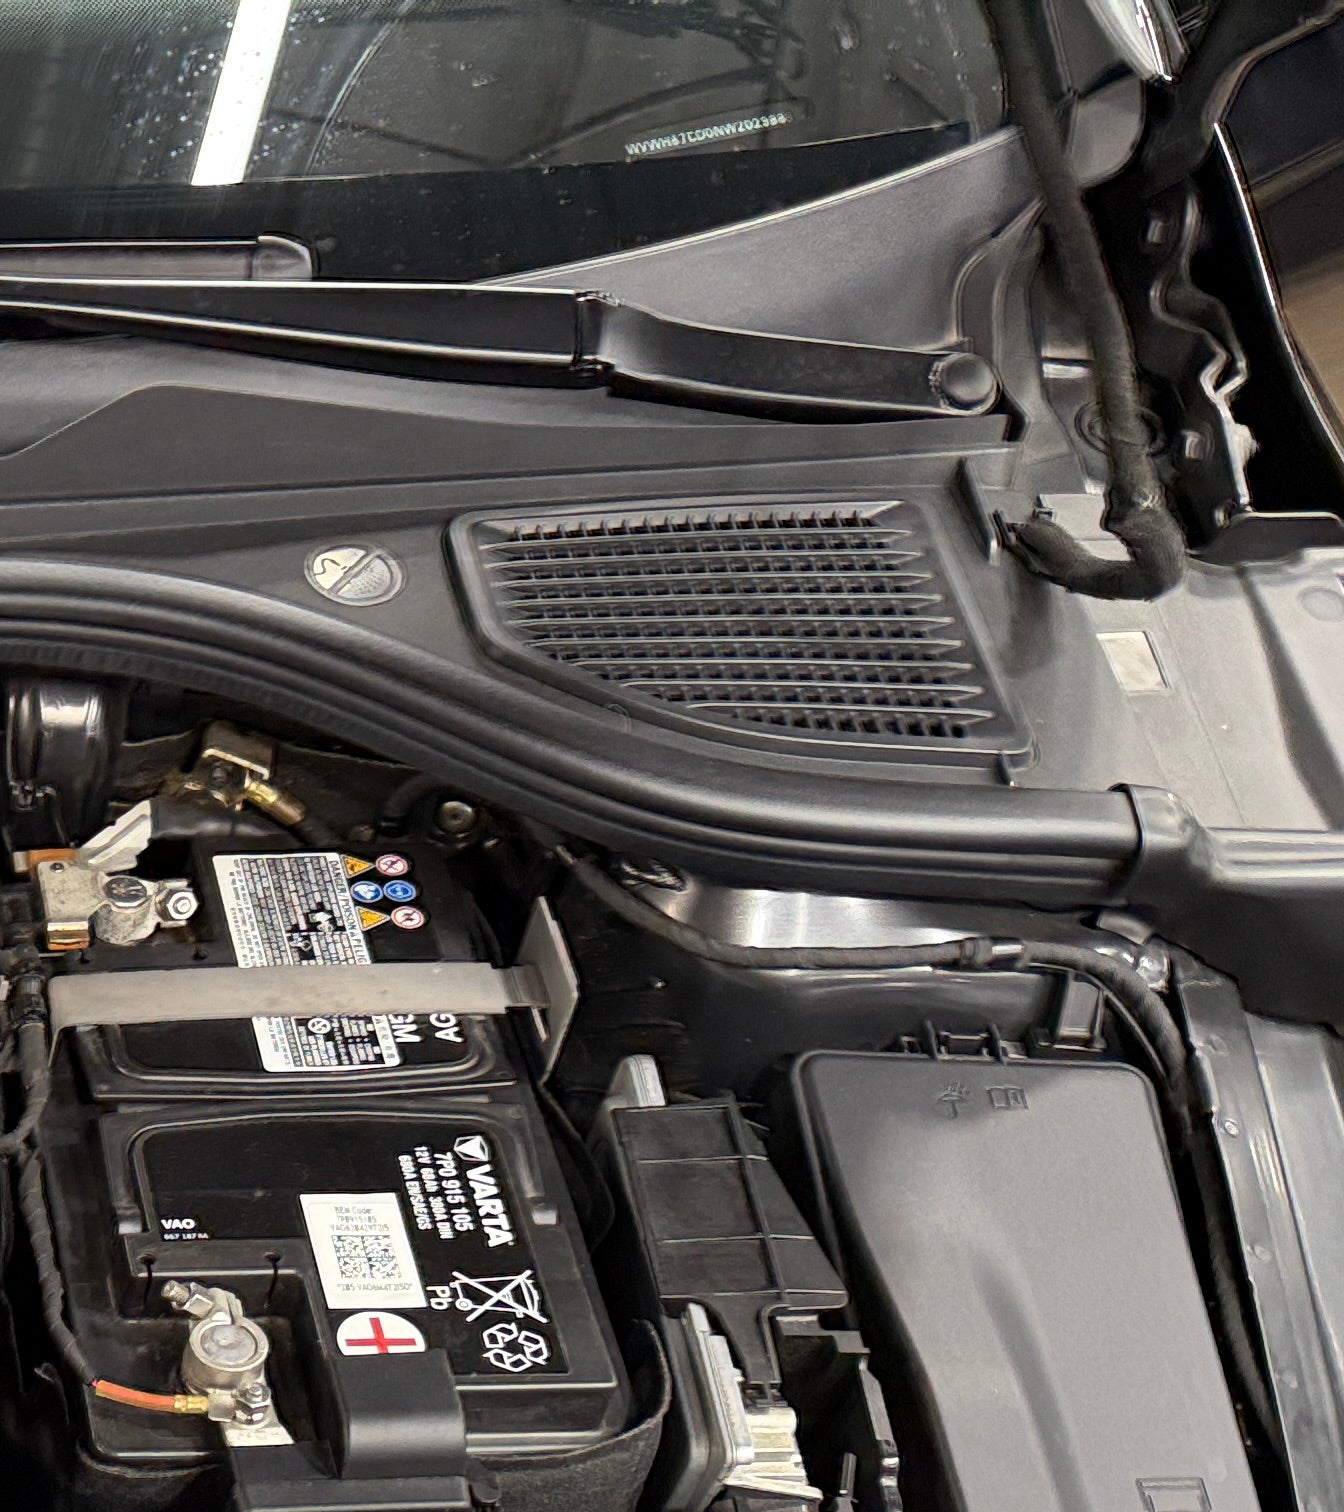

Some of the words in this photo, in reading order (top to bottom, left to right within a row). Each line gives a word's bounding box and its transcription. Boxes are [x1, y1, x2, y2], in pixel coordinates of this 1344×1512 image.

[439, 1179, 463, 1204] 915
[466, 1164, 514, 1248] VARTA
[161, 1218, 196, 1230] VAO
[448, 1207, 473, 1232] 105
[425, 1285, 452, 1311] Pb
